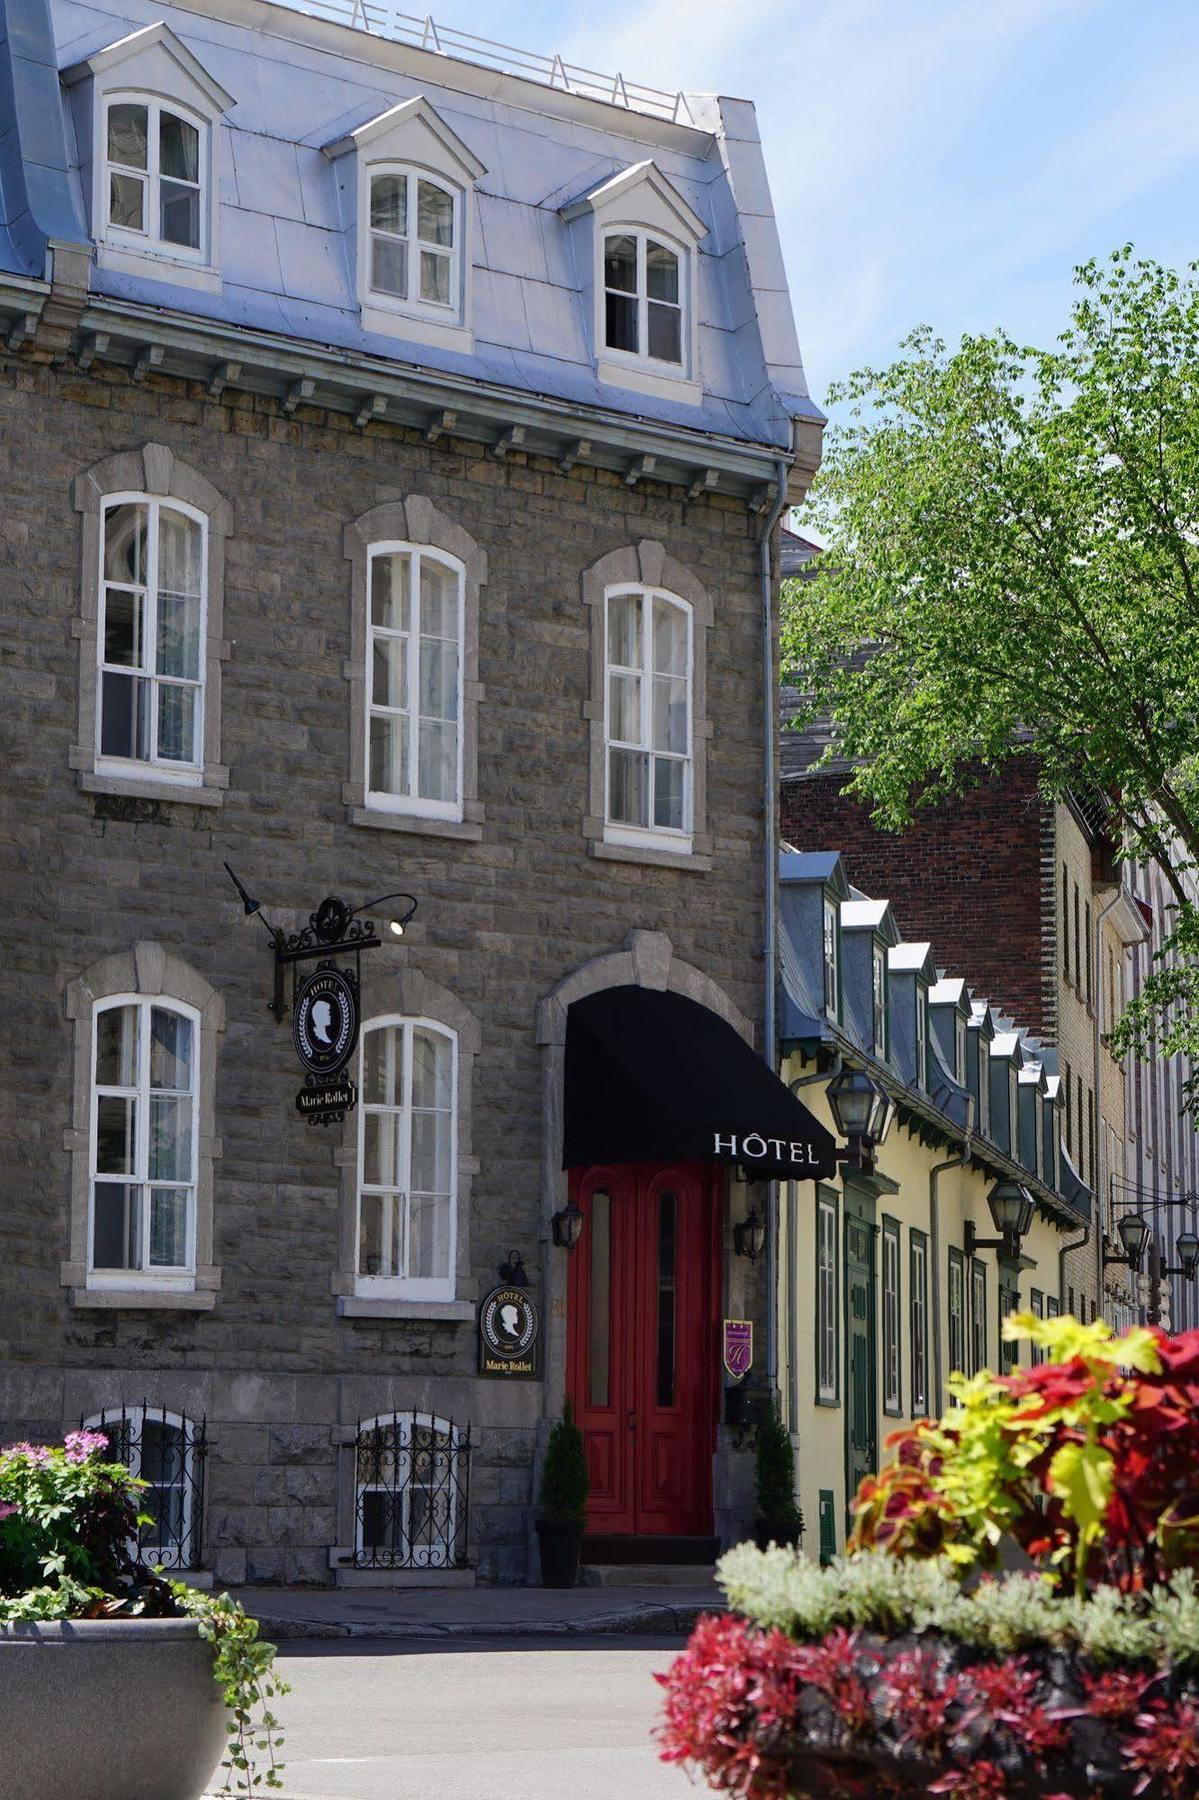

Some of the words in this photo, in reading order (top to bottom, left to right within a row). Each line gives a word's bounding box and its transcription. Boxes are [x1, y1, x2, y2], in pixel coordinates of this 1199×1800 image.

[301, 1094, 324, 1107] Marie
[324, 1090, 348, 1104] Rollet
[713, 1133, 819, 1164] HÔTEL
[486, 1360, 508, 1371] Marie
[509, 1360, 532, 1372] Rollet
